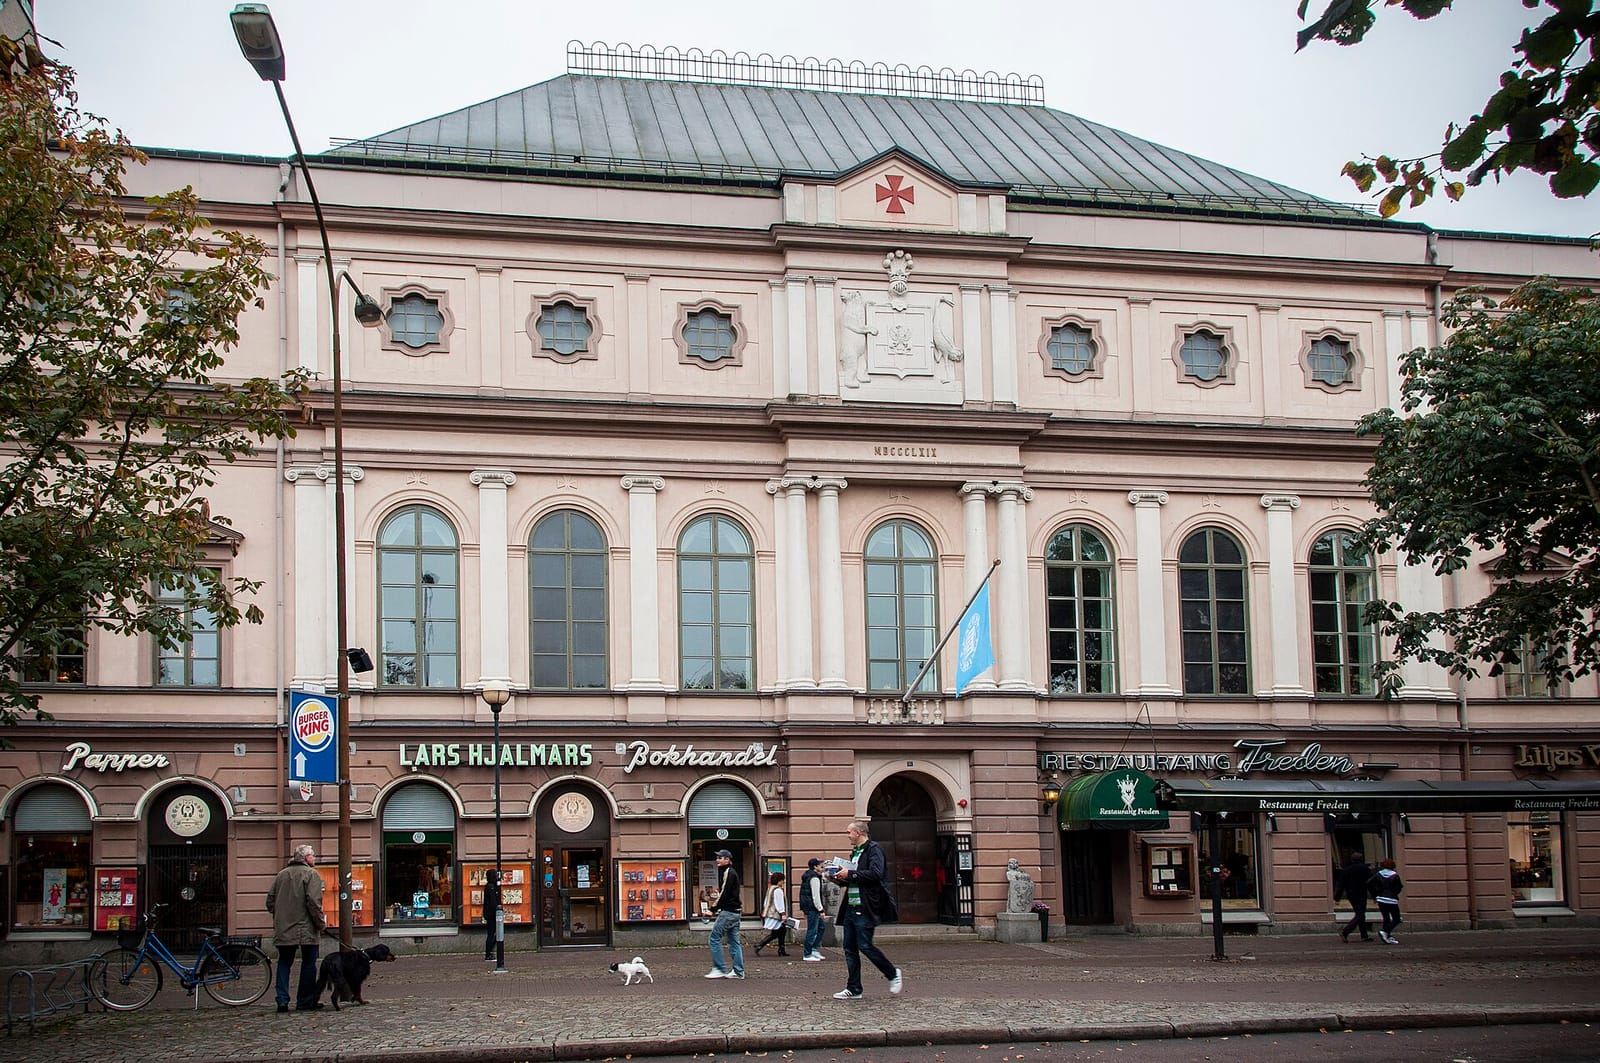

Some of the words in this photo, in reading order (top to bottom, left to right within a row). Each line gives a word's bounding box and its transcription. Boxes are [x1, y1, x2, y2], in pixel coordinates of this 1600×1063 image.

[298, 711, 328, 725] BURGER
[300, 720, 329, 737] KING
[62, 742, 170, 772] Papper
[399, 743, 460, 766] LARS
[468, 743, 592, 766] HJALMARS
[623, 740, 777, 773] Bokhandel
[1041, 752, 1231, 771] RESTAURANG
[1233, 739, 1354, 774] Freden
[1514, 744, 1584, 772] Liljas
[1099, 807, 1137, 816] Restaurang
[1137, 807, 1160, 815] Freden
[1258, 799, 1314, 811] Restaurang
[1316, 799, 1350, 810] Freden
[1514, 799, 1566, 809] Restaurang
[1568, 797, 1599, 808] Freden
